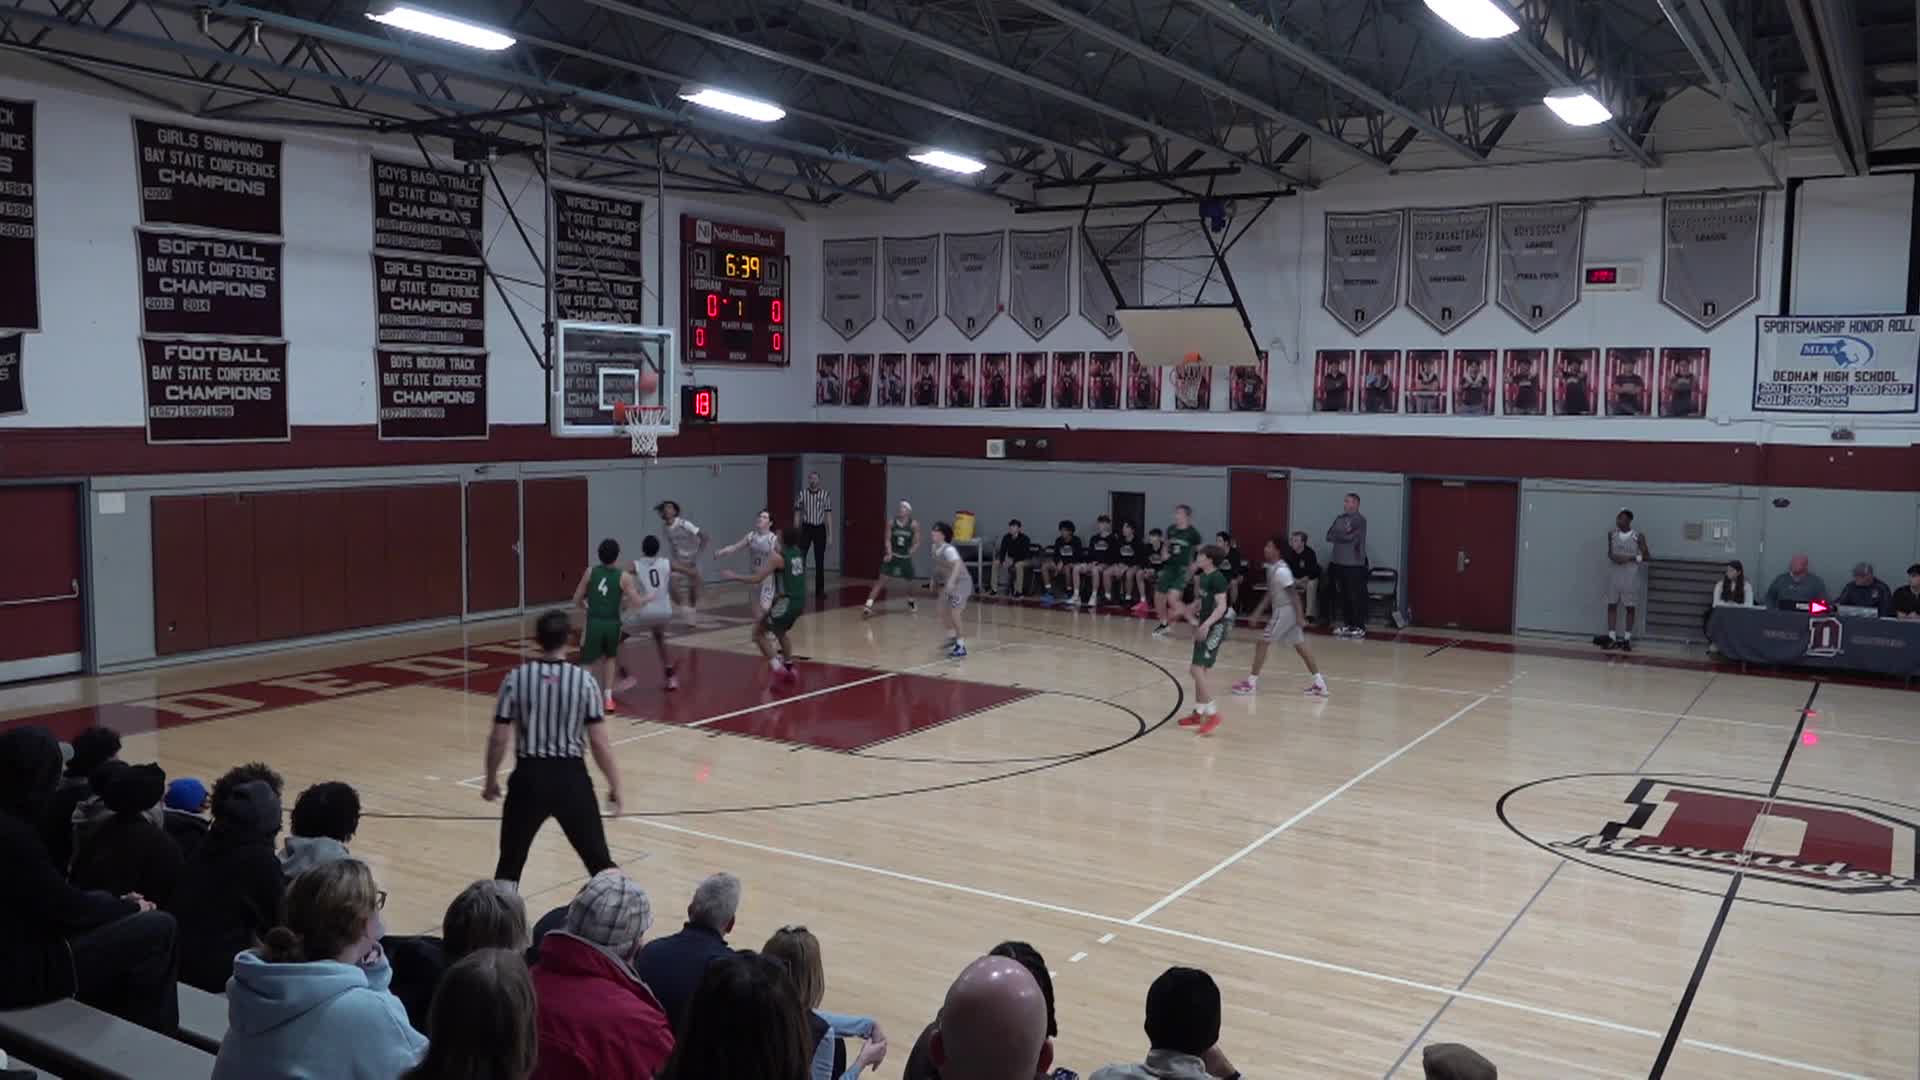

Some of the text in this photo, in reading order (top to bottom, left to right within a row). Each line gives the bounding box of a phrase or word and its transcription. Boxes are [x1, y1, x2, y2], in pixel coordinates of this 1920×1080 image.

[158, 128, 264, 158] GIRLS SWIMMING
[144, 147, 276, 178] BAY STATE CONFERENCE
[378, 165, 407, 180] BOYS
[159, 168, 266, 197] CHAMPIONS
[379, 183, 479, 208] BAY STATE CONERENCE
[389, 202, 471, 224] CHAMPIONS
[158, 238, 265, 262] SOFTBALL
[147, 258, 275, 281] BAY STATE CONFERENCE
[384, 261, 476, 281] GIRLS SOCCER
[726, 253, 760, 279] 6:39
[159, 277, 266, 298] CHAMPIONS
[380, 279, 480, 298] BAY STATE CONFERENCE
[390, 297, 472, 314] CHAMPIONS
[707, 294, 718, 317] 0
[771, 299, 782, 323] 0
[1764, 319, 1915, 333] SPORTSMANSHIP HONOR ROLL
[695, 328, 705, 347] 0
[772, 332, 782, 351] 0
[164, 345, 268, 363] FOOTBALL
[1803, 344, 1839, 354] MIAA
[390, 356, 413, 368] BOYS
[449, 358, 475, 370] TRACK
[152, 365, 281, 382] BAY STATE CONFERENCE
[383, 373, 482, 388] BAY STATE CONFERENCE
[1773, 371, 1898, 382] DEDHAM HIGH SCHOOL
[165, 385, 272, 401] CHAMPIONS
[393, 391, 475, 404] CHAMPIONS
[598, 576, 609, 597] 4
[649, 568, 660, 588] 0
[1806, 616, 1844, 657] D
